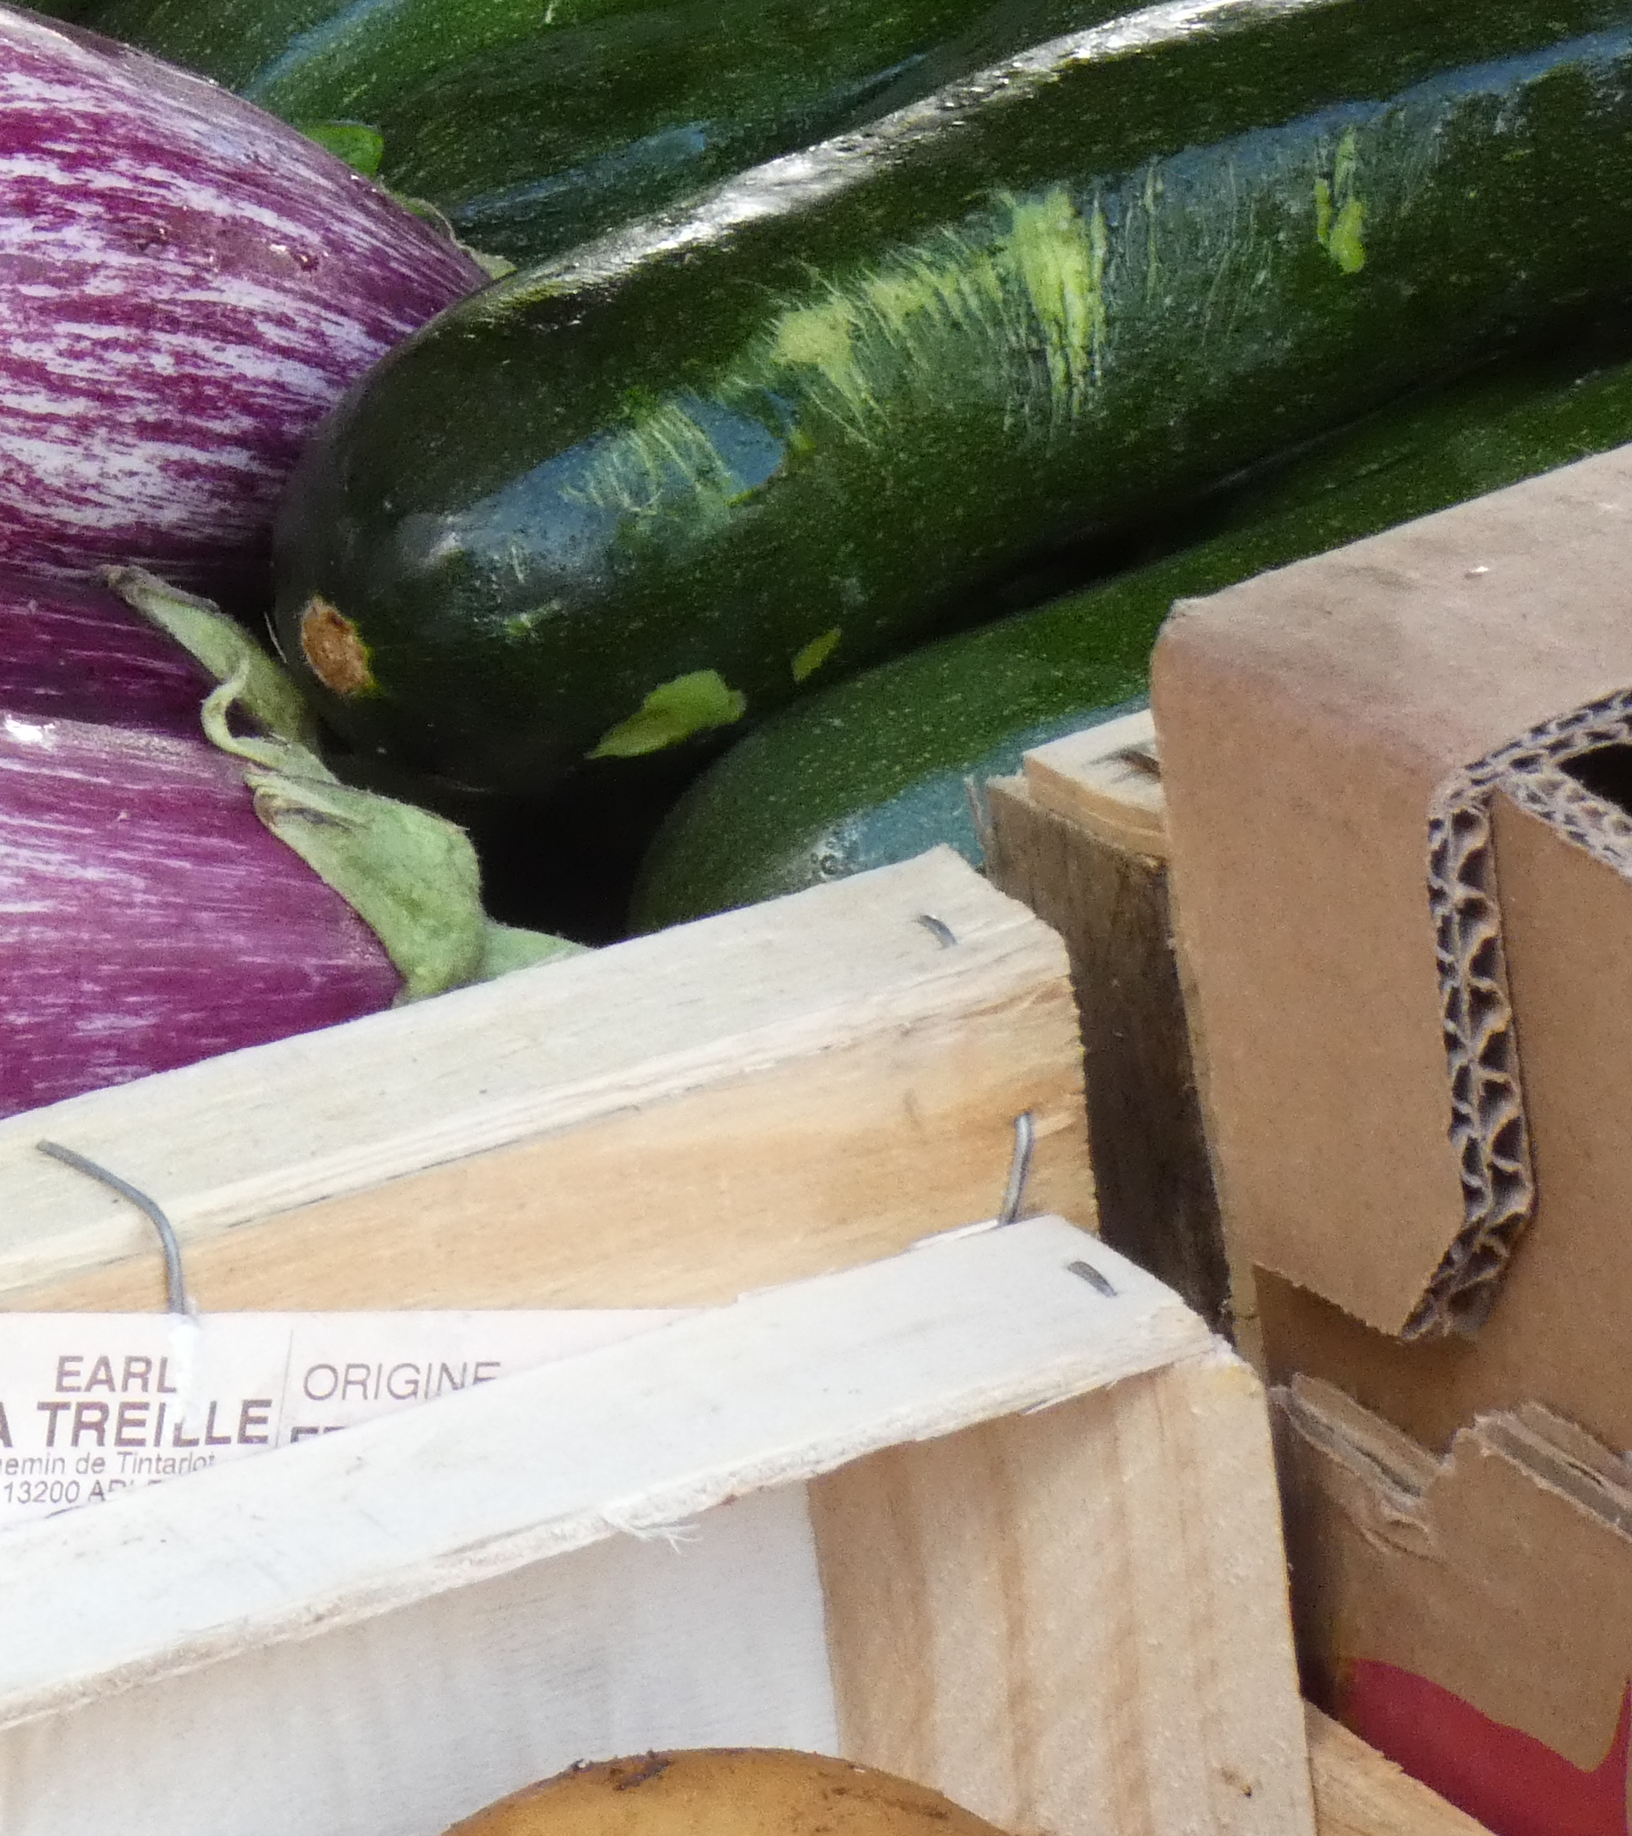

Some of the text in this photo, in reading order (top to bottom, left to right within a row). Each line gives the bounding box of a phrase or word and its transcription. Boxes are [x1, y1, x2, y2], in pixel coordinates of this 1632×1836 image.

[55, 1355, 177, 1392] EARL
[37, 1398, 273, 1448] TREILLE
[75, 1452, 106, 1476] de
[2, 1480, 80, 1505] 13200
